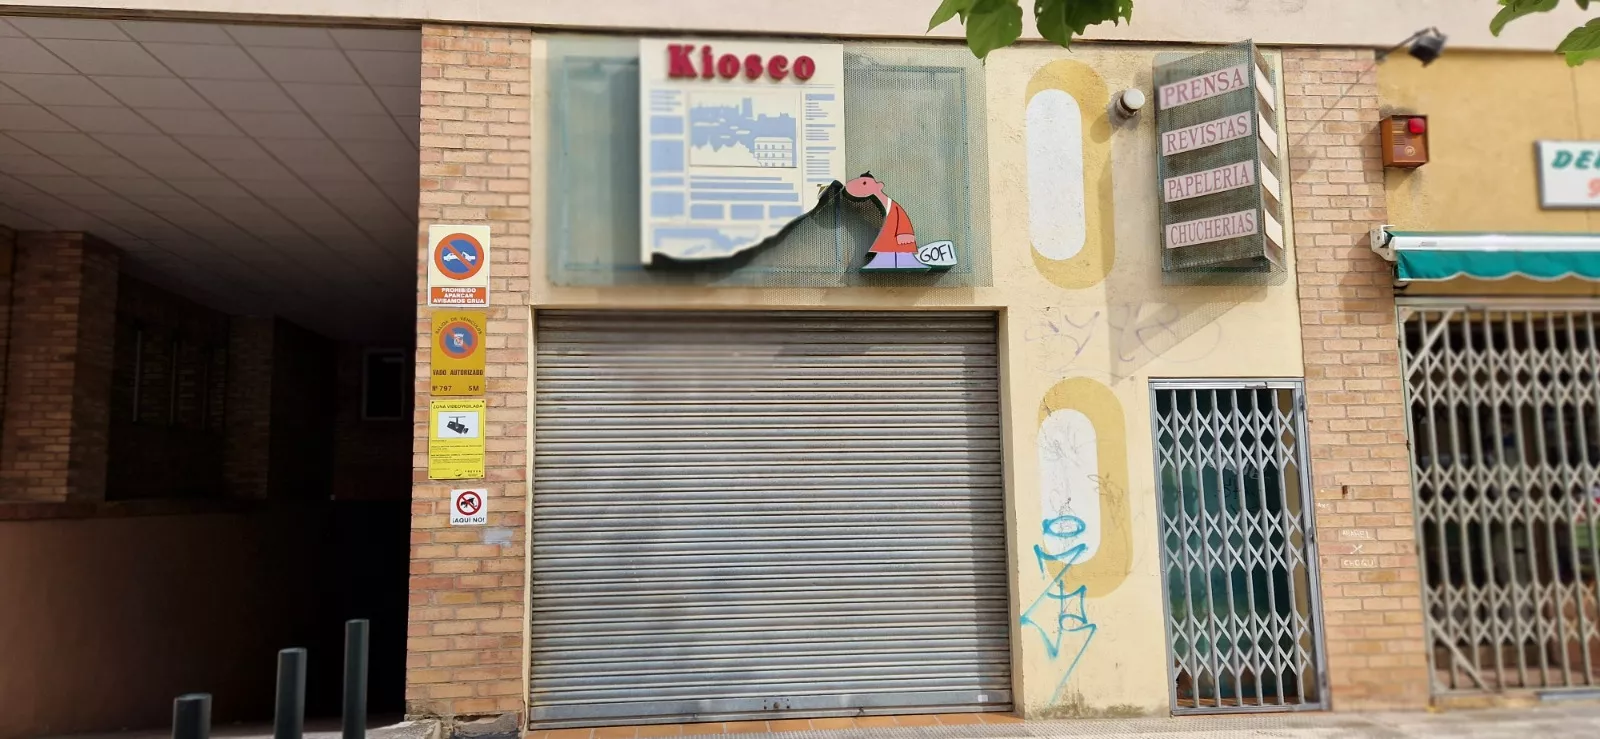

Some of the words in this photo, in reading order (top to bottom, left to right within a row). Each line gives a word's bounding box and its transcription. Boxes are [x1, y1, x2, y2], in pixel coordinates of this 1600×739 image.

[667, 43, 816, 81] Kiosco
[1164, 68, 1245, 107] PRENSA
[1166, 115, 1248, 153] REVISTAS
[1168, 163, 1250, 200] PAPELERIA
[1170, 212, 1254, 246] CHUCHERIAS
[919, 243, 954, 262] GOFI
